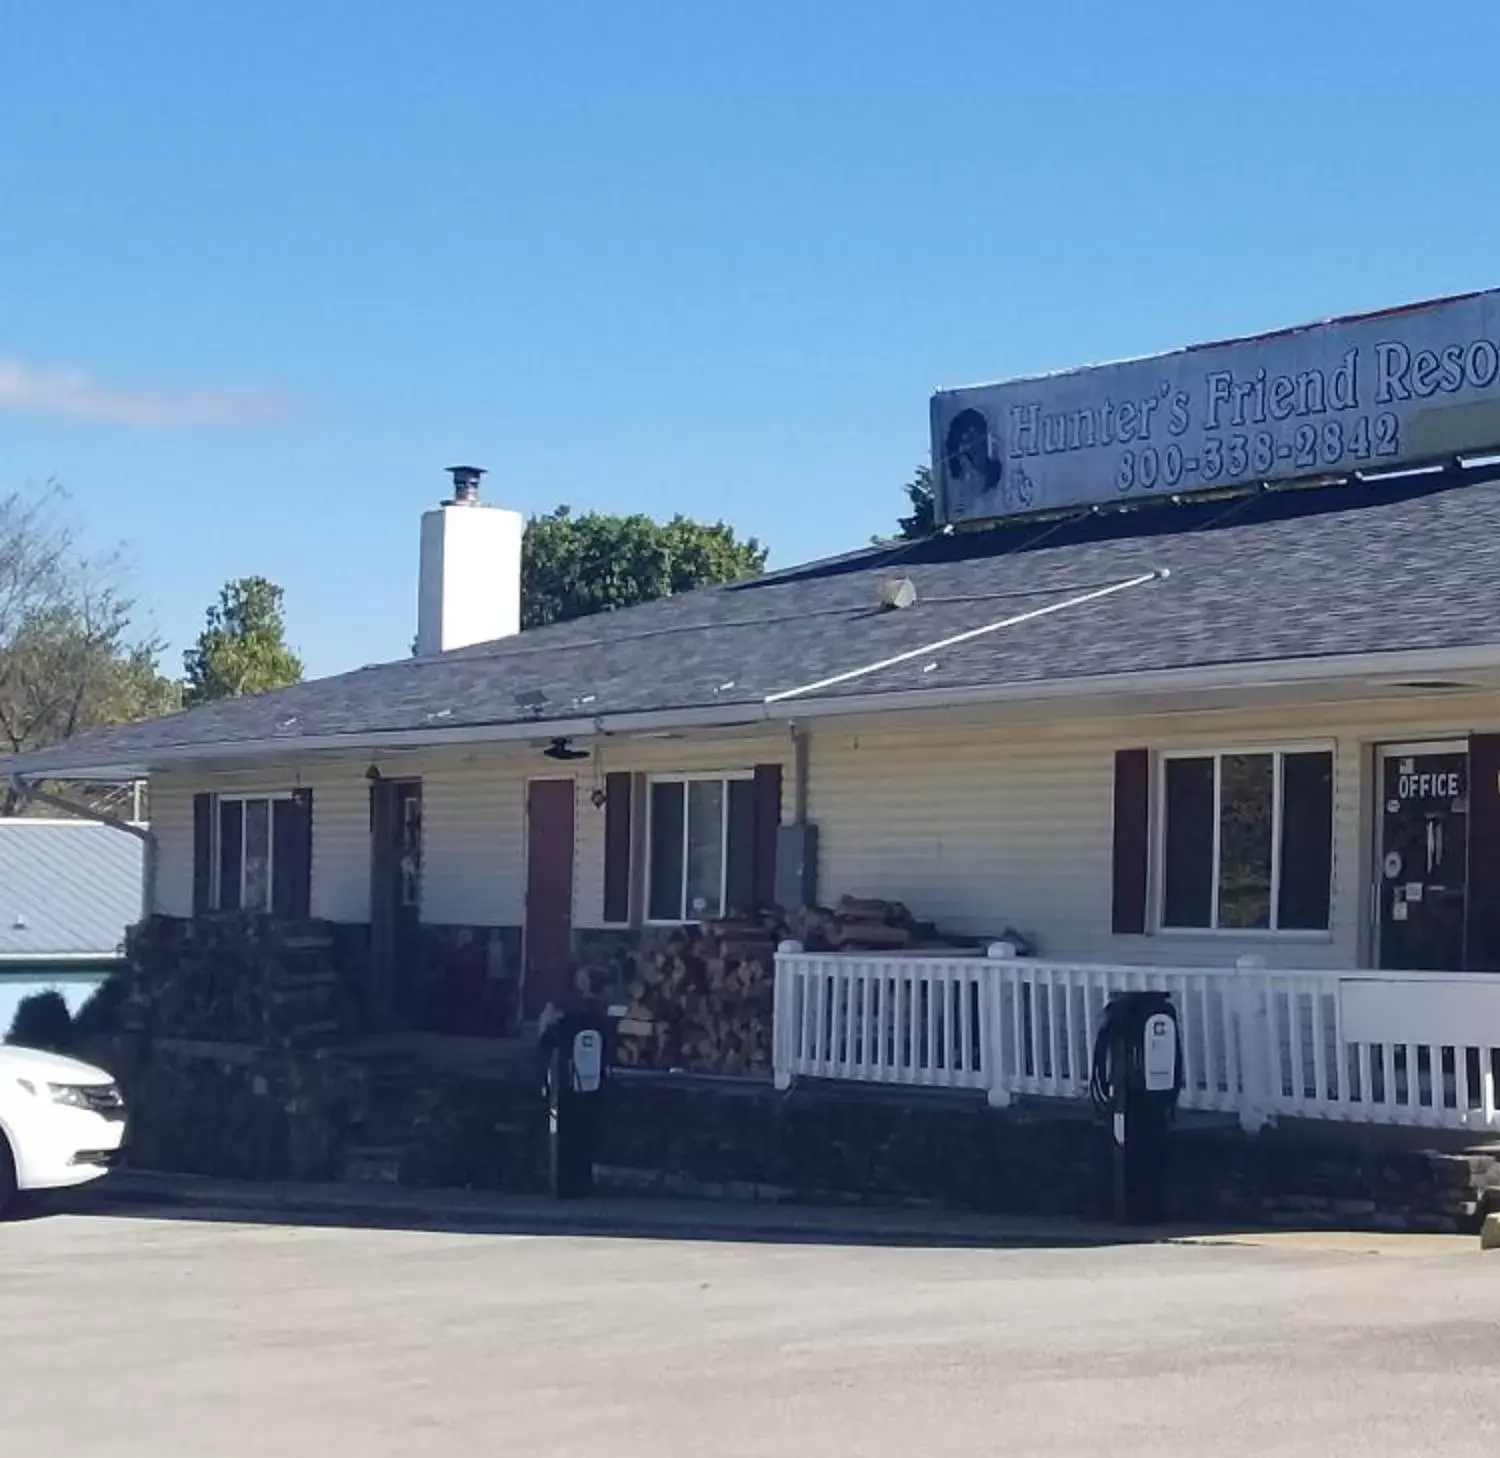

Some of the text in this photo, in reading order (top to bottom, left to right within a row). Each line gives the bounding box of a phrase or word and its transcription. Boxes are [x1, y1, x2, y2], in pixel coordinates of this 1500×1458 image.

[1008, 380, 1192, 459] Hunter's
[1203, 348, 1360, 431] Friend
[1114, 410, 1401, 493] 800-338-2842
[1399, 773, 1460, 798] OFFICE
